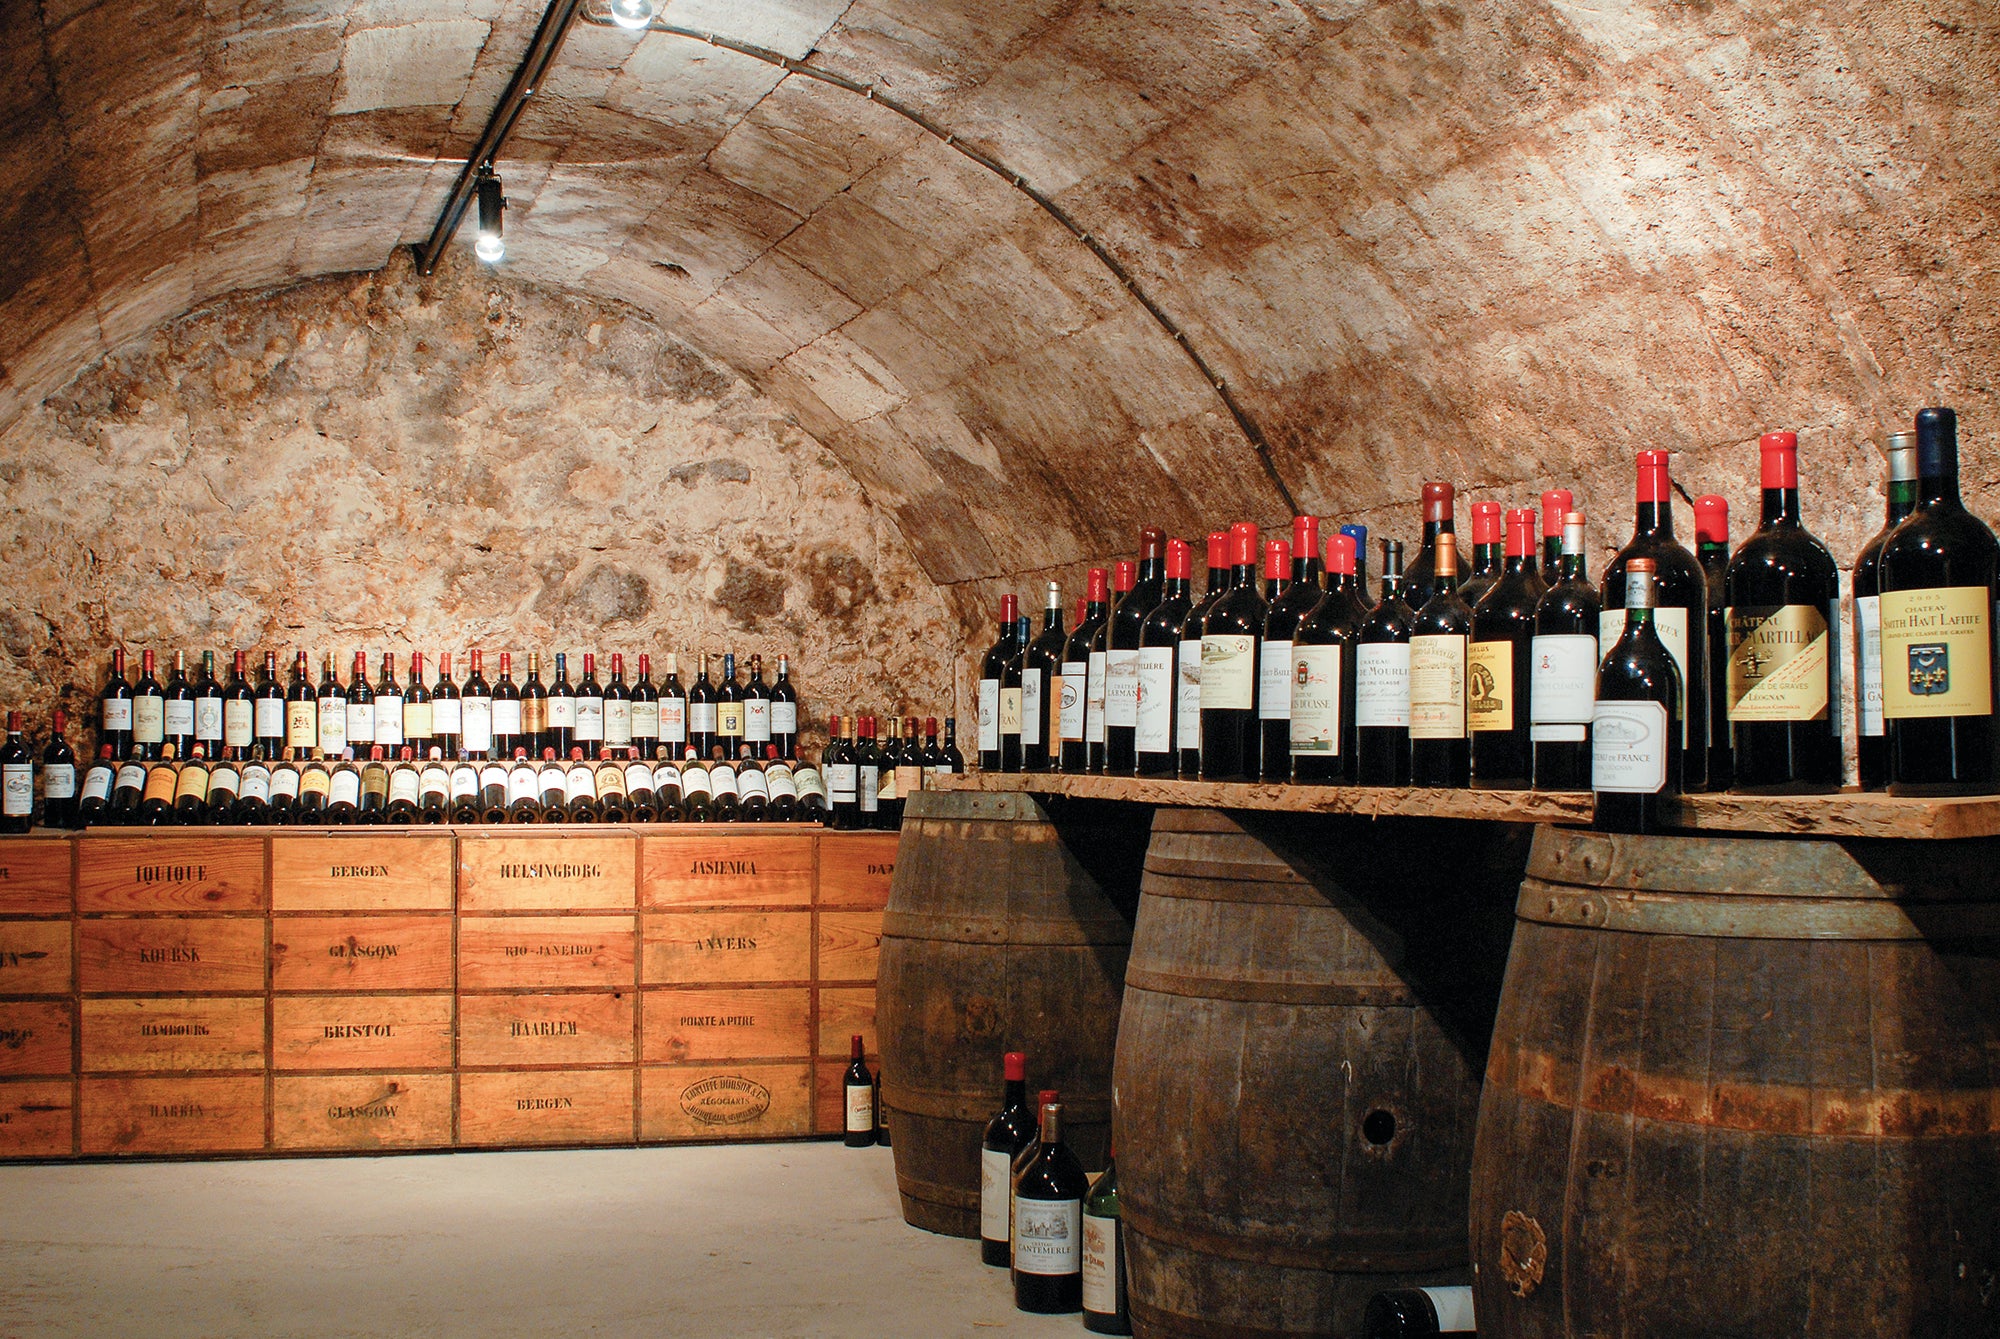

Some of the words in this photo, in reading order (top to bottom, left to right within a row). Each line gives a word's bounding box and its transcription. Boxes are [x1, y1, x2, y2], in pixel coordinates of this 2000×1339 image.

[1779, 683, 1809, 691] GRAVES
[1617, 753, 1650, 763] FRANCE
[136, 865, 207, 886] IQUIQUE
[331, 865, 391, 878] BERGEN
[500, 863, 600, 879] HELSINGBORG
[695, 937, 757, 951] ANVERS
[141, 947, 200, 963] KOURSK
[329, 944, 400, 959] GLASGOW
[511, 1020, 578, 1037] HAARLEM
[680, 1016, 717, 1027] POINTE
[718, 1016, 726, 1027] A
[727, 1016, 756, 1027] PITRE
[141, 1024, 209, 1036] HAMBOURG
[324, 1024, 396, 1039] BRISTOL
[516, 1097, 573, 1111] BERGEN
[327, 1105, 398, 1119] GLASGOW
[1018, 1243, 1072, 1255] CANTEMERLE
